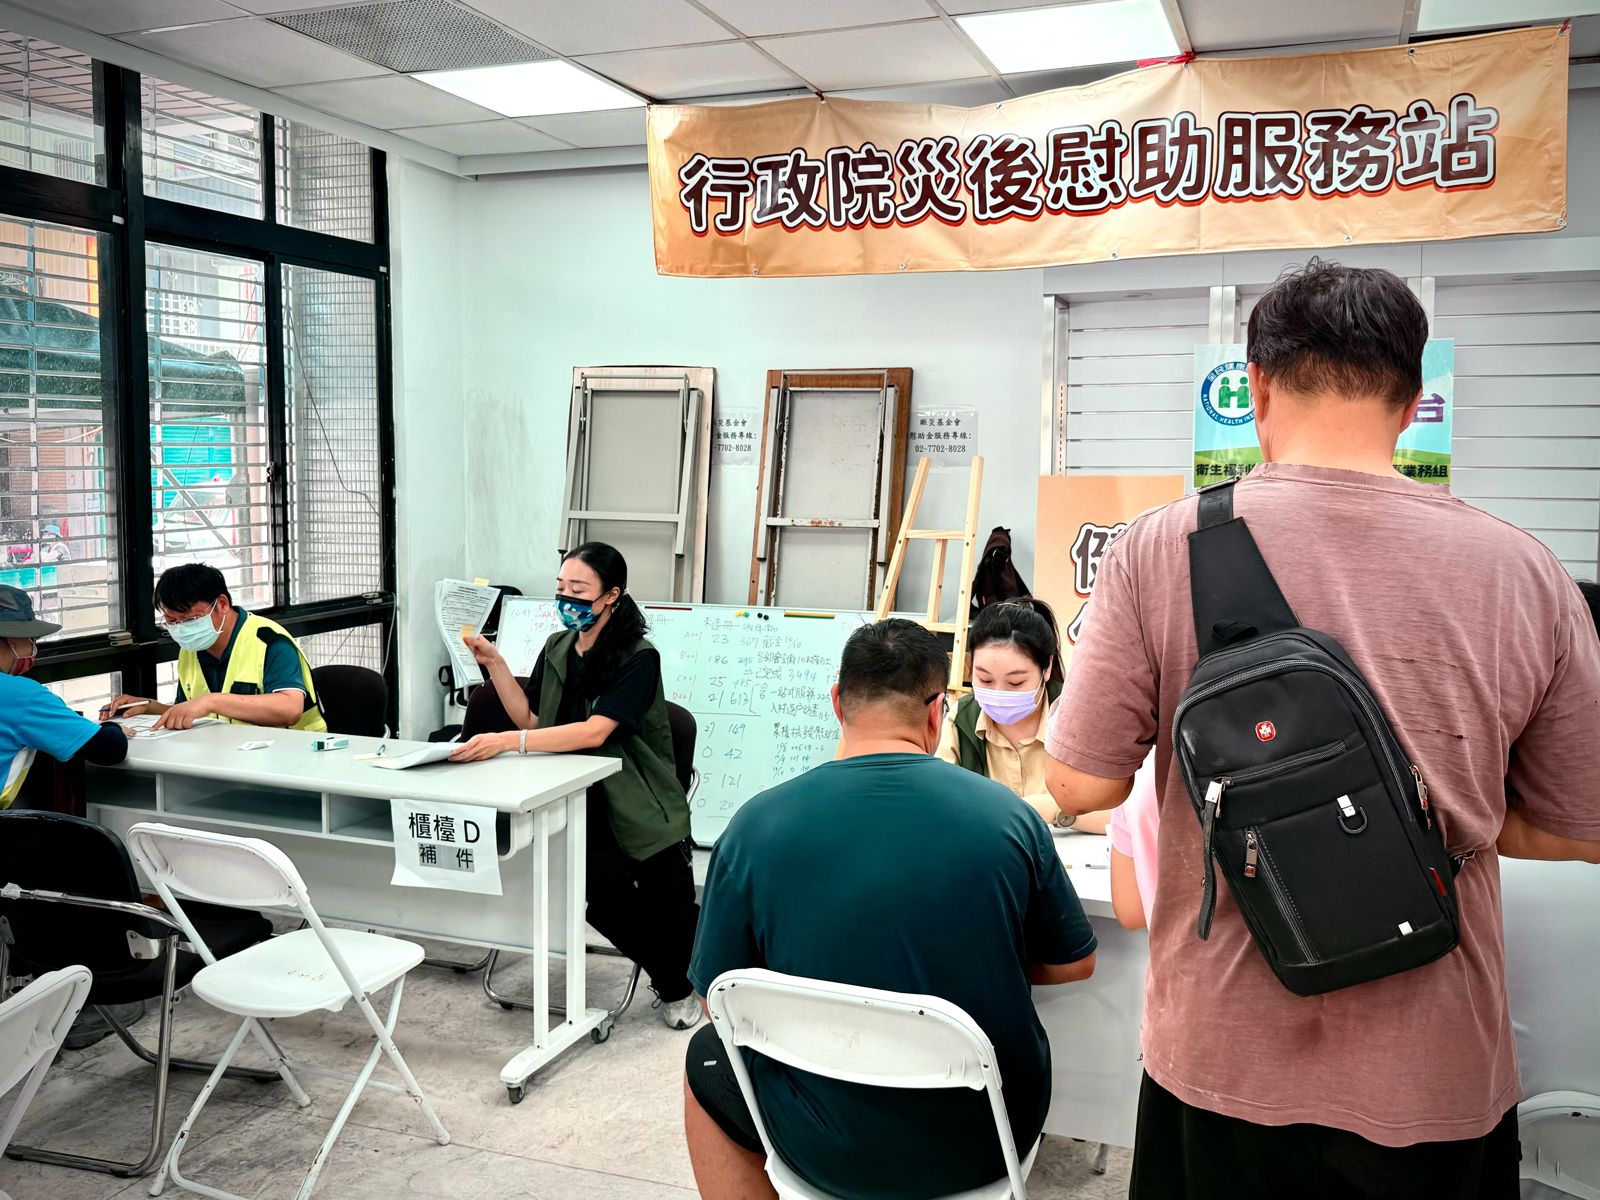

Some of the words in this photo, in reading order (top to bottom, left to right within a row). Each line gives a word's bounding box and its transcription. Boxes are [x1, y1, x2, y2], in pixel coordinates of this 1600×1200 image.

[679, 94, 1499, 235] 行政院災後慰助服務站
[1202, 393, 1219, 420] NATIONAL
[1220, 416, 1243, 425] HEALTH
[712, 431, 757, 440] 金服務專線:
[914, 444, 967, 453] 02-7702-8028
[1196, 463, 1256, 476] 衛生福利
[712, 634, 729, 645] 23
[707, 655, 729, 665] 186
[709, 676, 727, 688] 25
[788, 669, 817, 682] 3494
[724, 748, 743, 760] 42
[702, 772, 713, 784] 5
[721, 773, 742, 789] 121
[408, 812, 456, 843] 櫃檯
[463, 819, 481, 844] D
[419, 844, 437, 865] 補
[456, 848, 474, 869] 件
